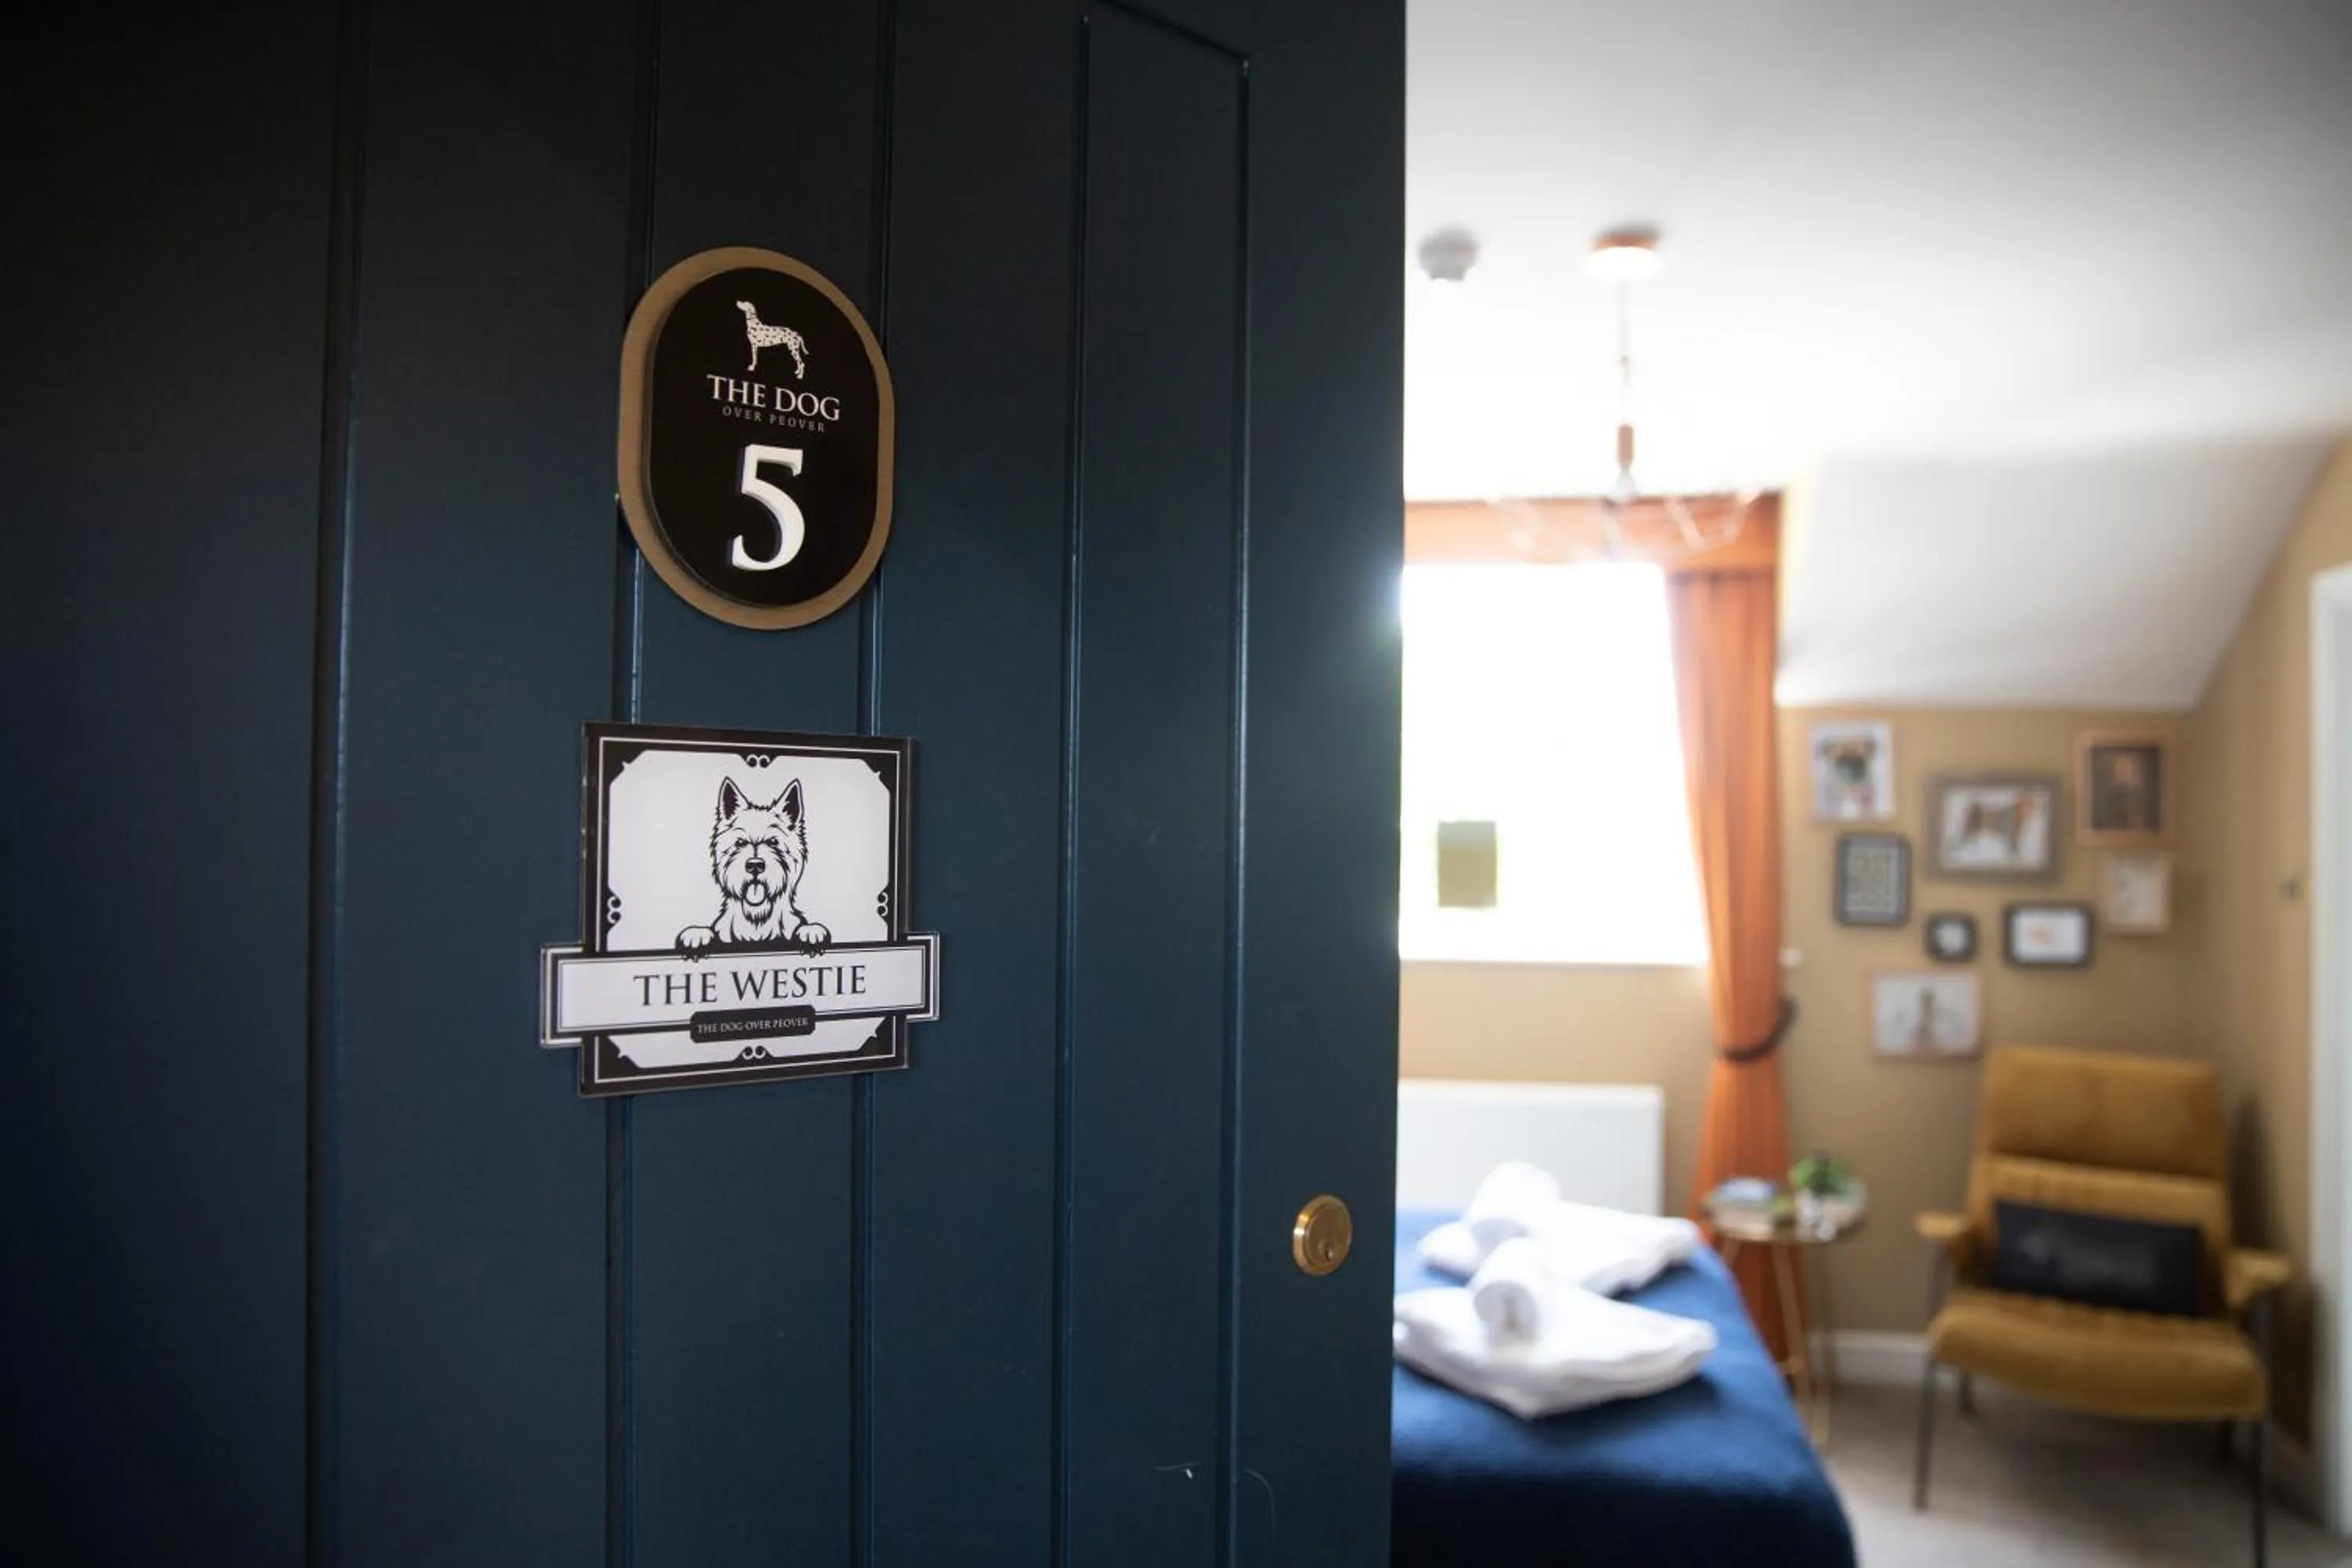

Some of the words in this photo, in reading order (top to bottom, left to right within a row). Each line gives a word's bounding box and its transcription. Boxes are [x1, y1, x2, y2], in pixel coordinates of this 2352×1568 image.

[707, 374, 766, 408] THE
[775, 387, 840, 421] DOG
[722, 405, 761, 422] OVER
[769, 414, 824, 433] PEOVER
[731, 444, 805, 571] 5
[633, 971, 717, 1006] THE
[731, 965, 866, 1000] WESTIE
[698, 1022, 717, 1034] THE
[720, 1022, 743, 1033] DOG
[746, 1020, 772, 1031] OVER
[773, 1017, 808, 1029] PEOVER
